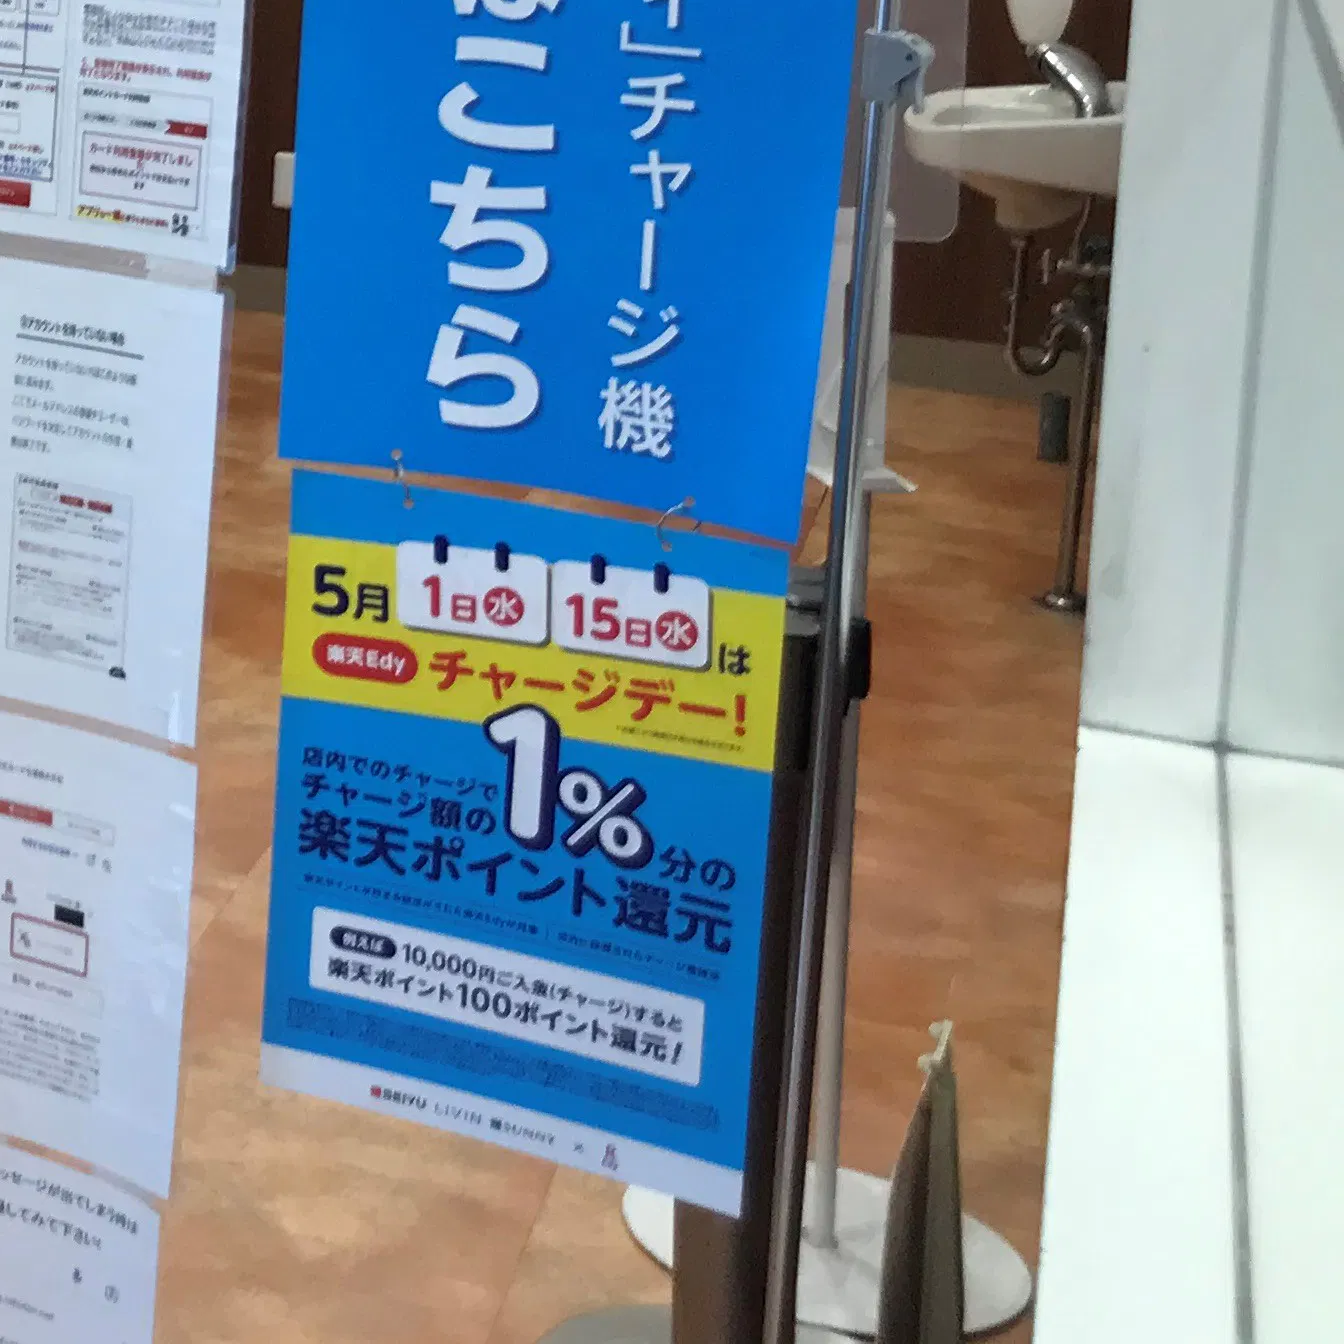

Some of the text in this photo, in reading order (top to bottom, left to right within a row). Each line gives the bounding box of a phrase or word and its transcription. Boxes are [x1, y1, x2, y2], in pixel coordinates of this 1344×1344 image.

[311, 563, 390, 625] 5月
[717, 643, 753, 676] は
[325, 642, 408, 677] 楽天Edy
[427, 650, 748, 737] チャージデー!
[301, 746, 500, 804] 店内でのチャージで
[301, 770, 497, 837] チャージ額の
[298, 808, 734, 956] 楽天ポイント還元
[327, 954, 684, 1066] 楽天ポイント100ポイント還元!
[400, 942, 685, 1034] 10,000円ご入金(チャージ)すると
